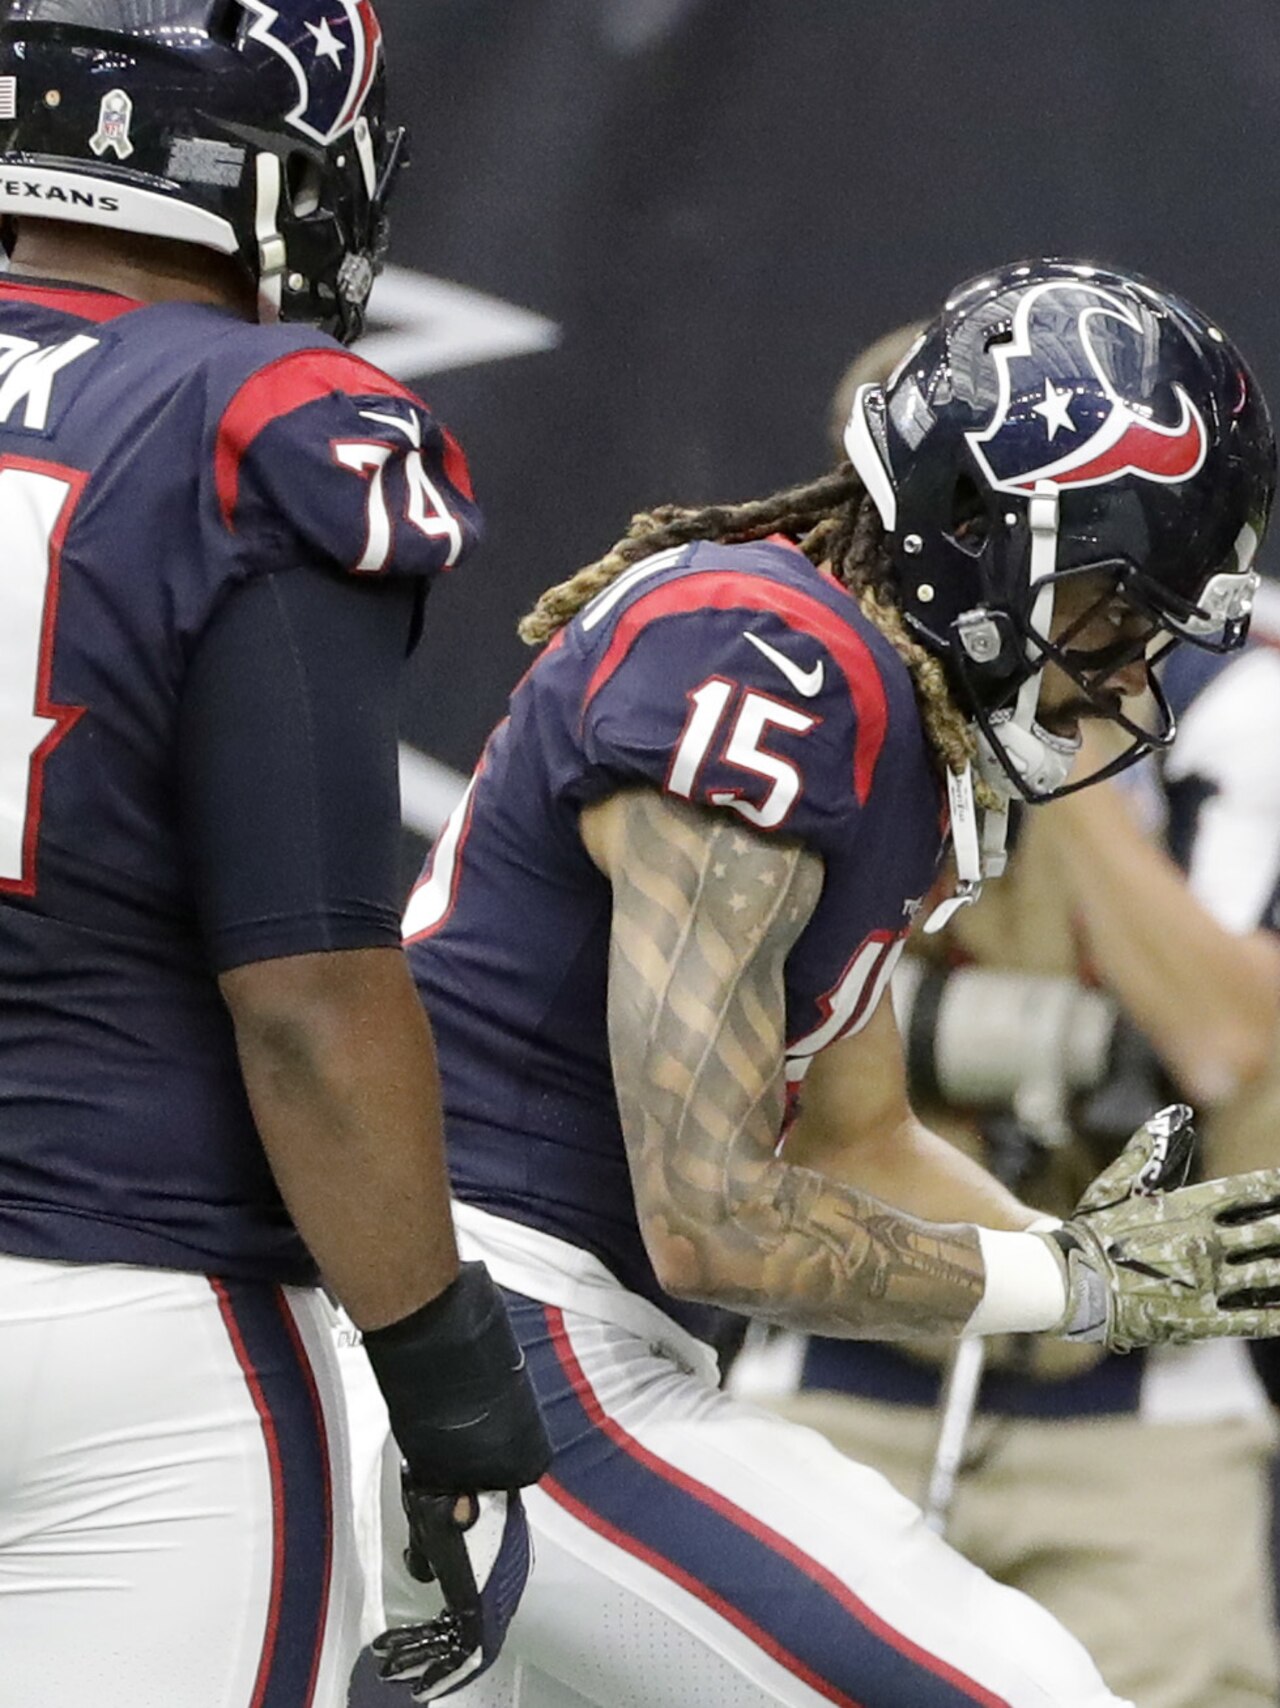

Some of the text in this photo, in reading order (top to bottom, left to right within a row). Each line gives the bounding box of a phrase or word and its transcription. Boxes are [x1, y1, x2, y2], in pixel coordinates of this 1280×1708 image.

[0, 179, 119, 211] EXANS
[329, 438, 463, 575] 74
[663, 673, 825, 833] 15
